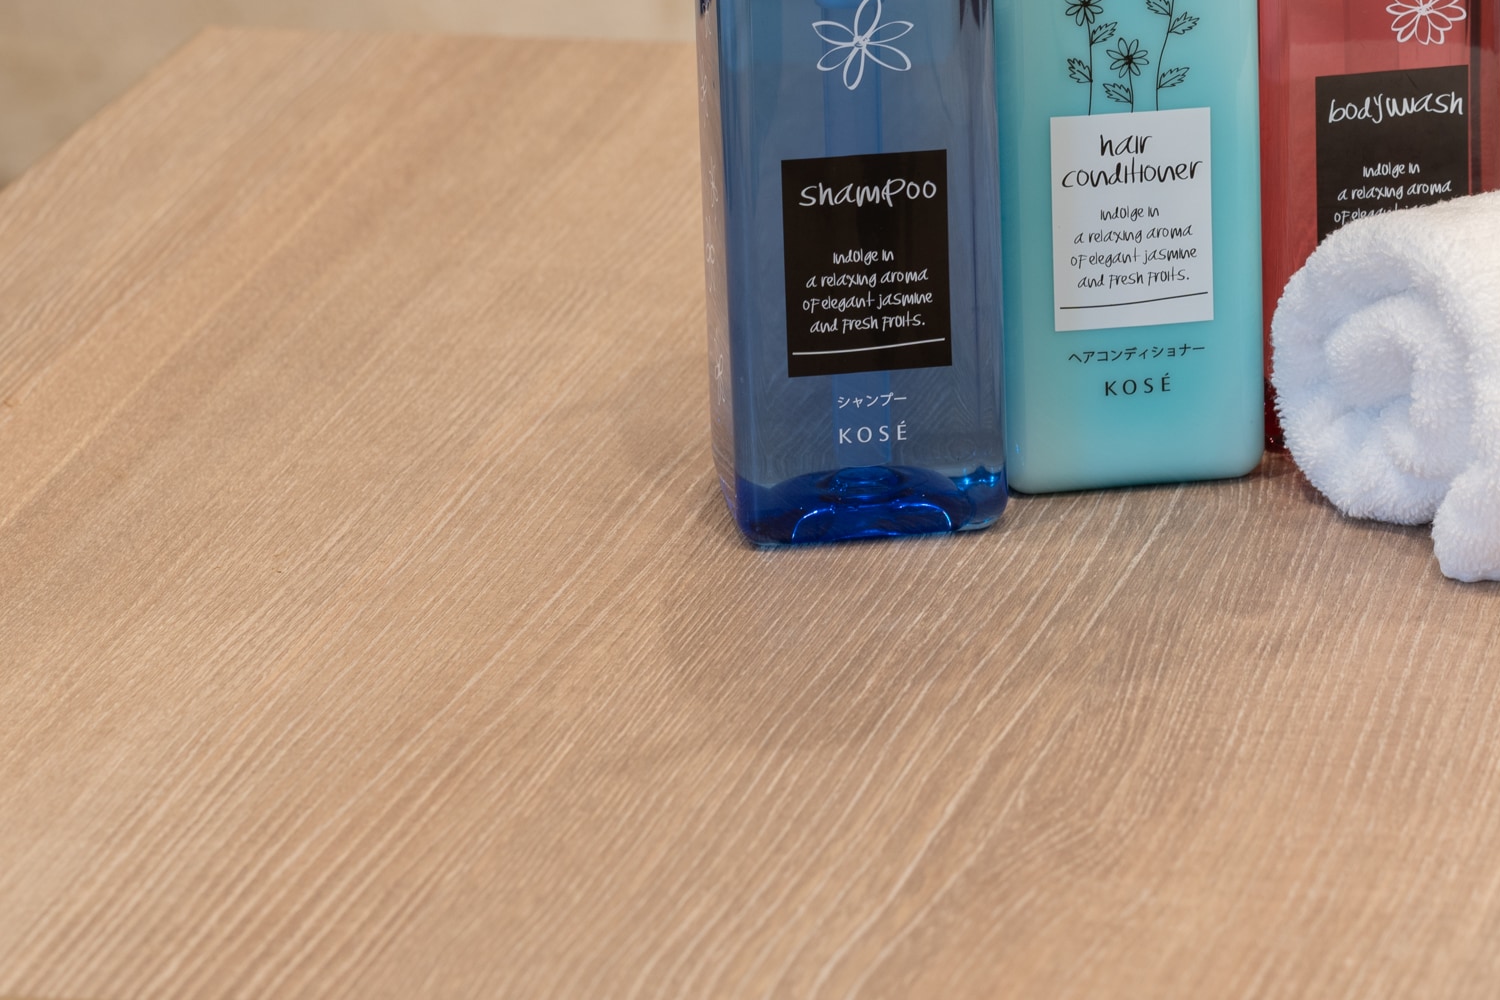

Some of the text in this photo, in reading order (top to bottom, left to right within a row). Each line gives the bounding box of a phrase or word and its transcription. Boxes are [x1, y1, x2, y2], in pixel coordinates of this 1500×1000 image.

[1328, 91, 1464, 124] bodywash
[1099, 133, 1153, 157] hair
[1061, 156, 1203, 188] conditioner
[798, 178, 938, 208] shampoo
[1337, 180, 1453, 202] a relaxing aroma
[1073, 224, 1193, 245] a relaxing aroma
[1088, 246, 1141, 268] elegant
[1142, 247, 1198, 265] jasmine
[805, 267, 930, 289] a relaxing aroma
[1077, 273, 1105, 289] and
[820, 290, 876, 313] elegant
[876, 291, 934, 310] jasmine
[809, 317, 839, 334] and
[1067, 343, 1206, 364] ヘアコンディショナー
[1104, 371, 1172, 397] KOSÉ
[837, 391, 908, 410] シャンプー
[838, 419, 908, 445] KOSÉ
